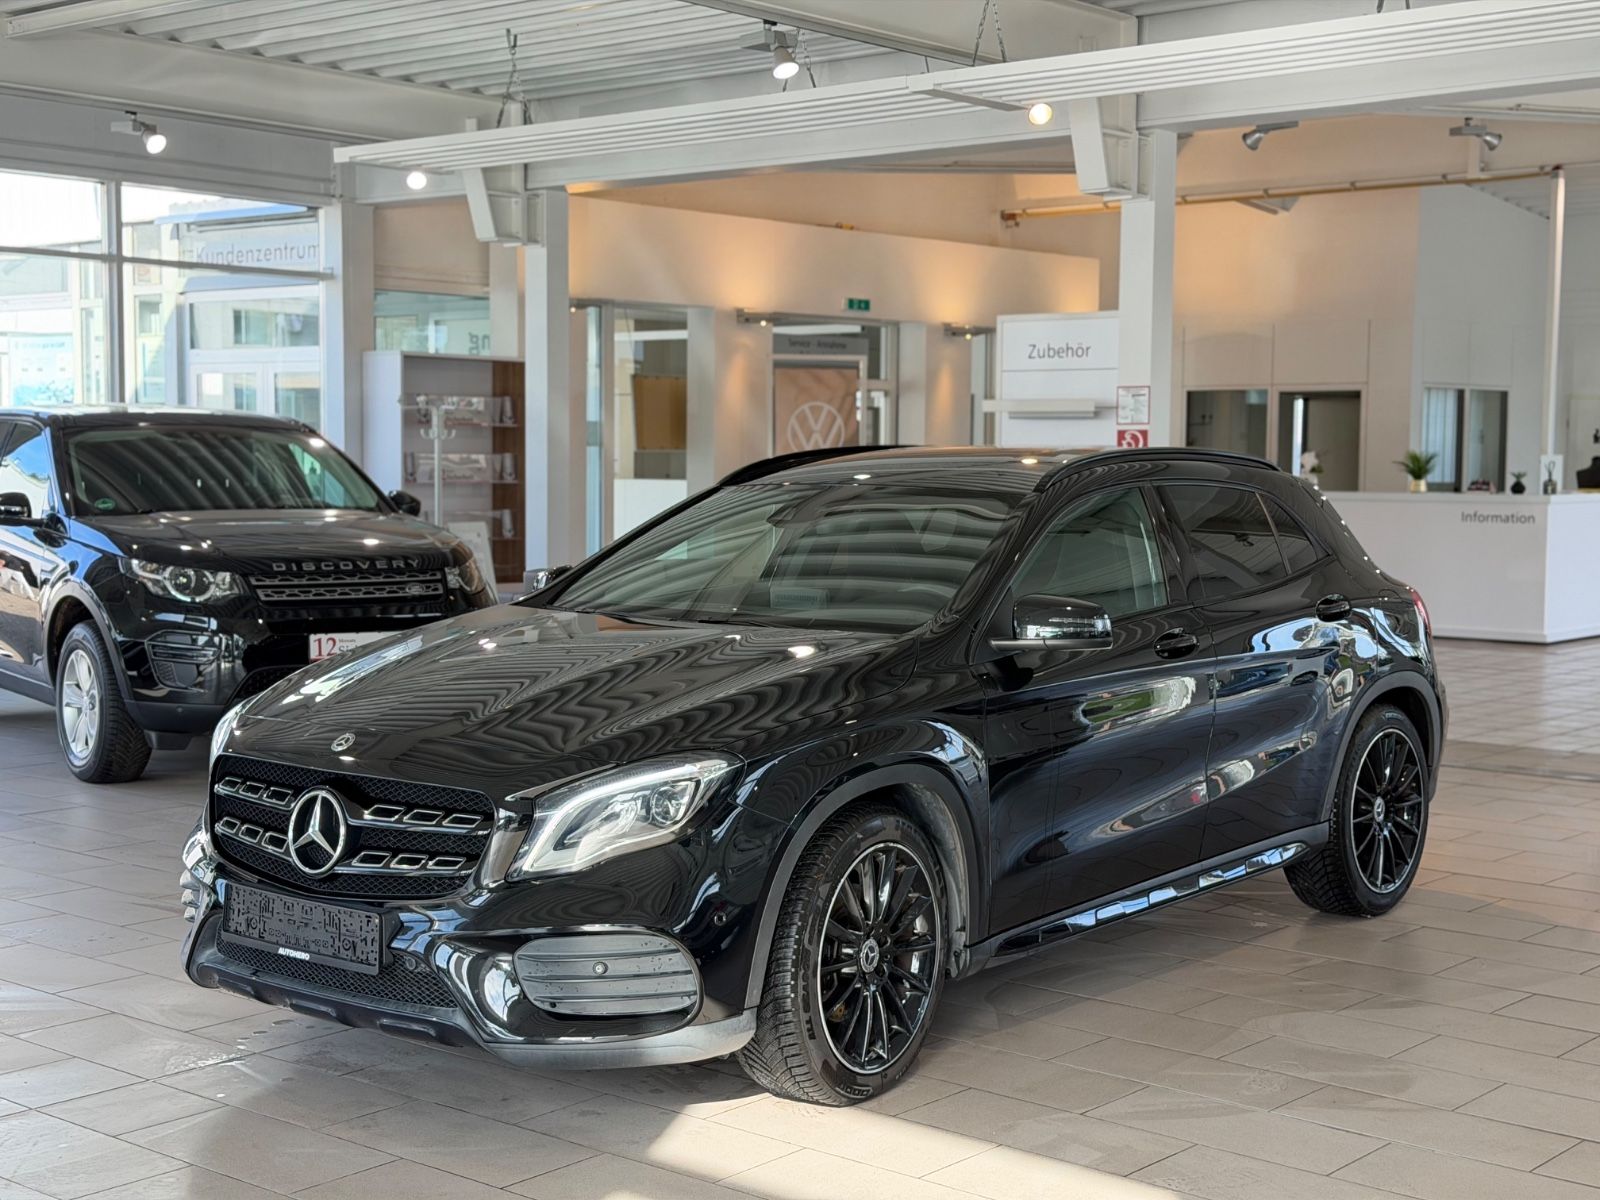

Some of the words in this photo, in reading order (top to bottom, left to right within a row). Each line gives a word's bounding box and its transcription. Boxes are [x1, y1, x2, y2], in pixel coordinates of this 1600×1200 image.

[1027, 342, 1092, 360] Zubehör
[1461, 511, 1536, 525] Information
[272, 559, 419, 572] DISCOVERY
[313, 637, 337, 656] 12
[277, 947, 310, 960] AUTOHERO
